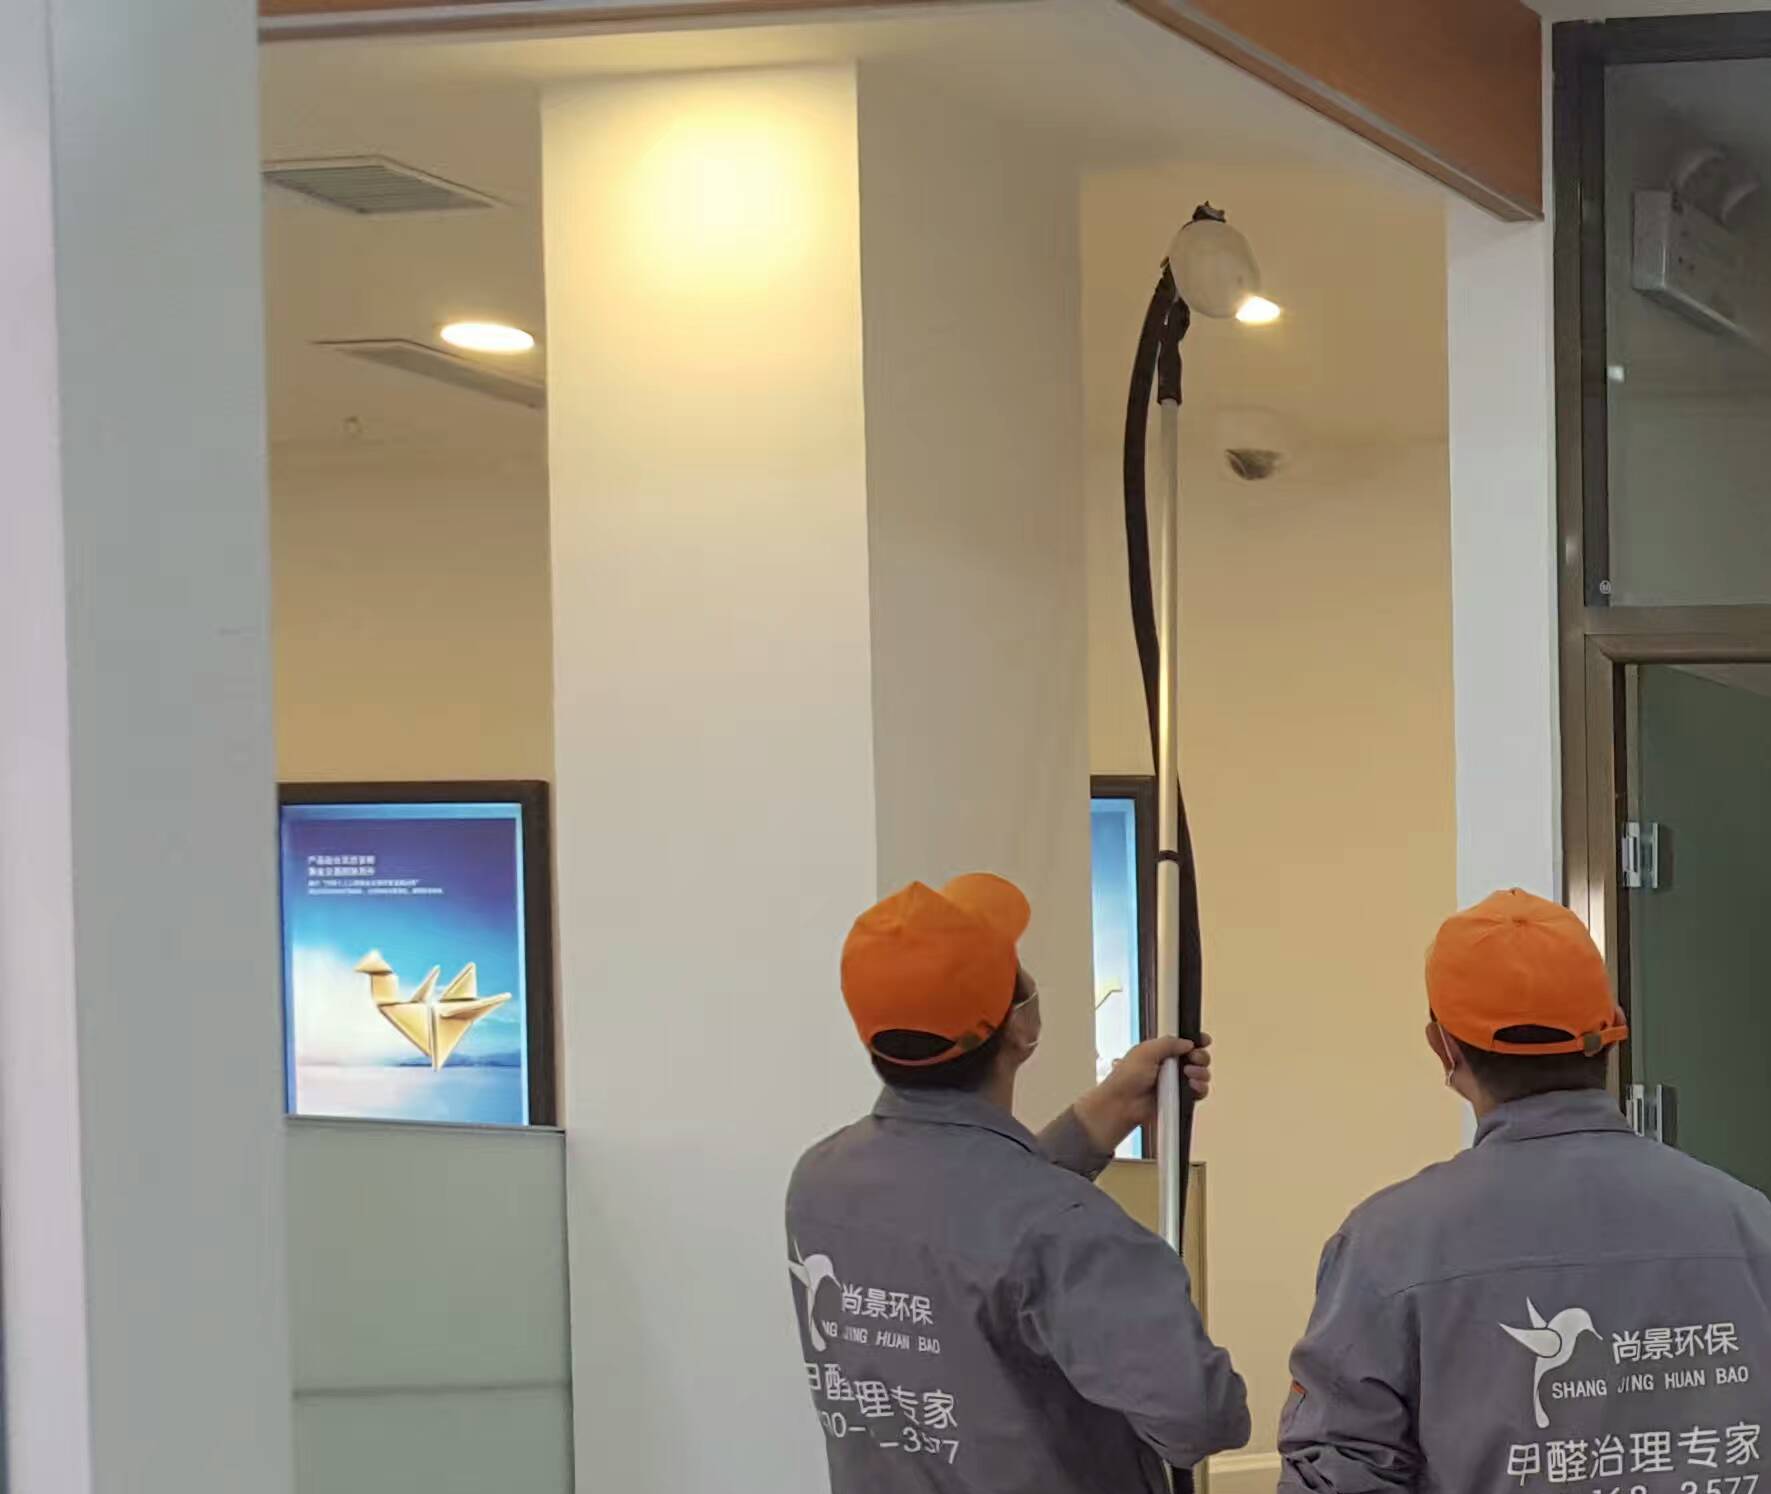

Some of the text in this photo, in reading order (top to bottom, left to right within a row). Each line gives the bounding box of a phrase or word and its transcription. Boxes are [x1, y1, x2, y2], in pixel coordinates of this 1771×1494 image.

[841, 1283, 934, 1326] 尚景环保
[875, 1331, 911, 1350] HUAN
[918, 1336, 941, 1354] BAO
[1611, 1321, 1740, 1365] 尚景环保
[1551, 1365, 1749, 1400] SHANG JING HUAN BAO
[1506, 1421, 1761, 1487] 甲醛治理专家
